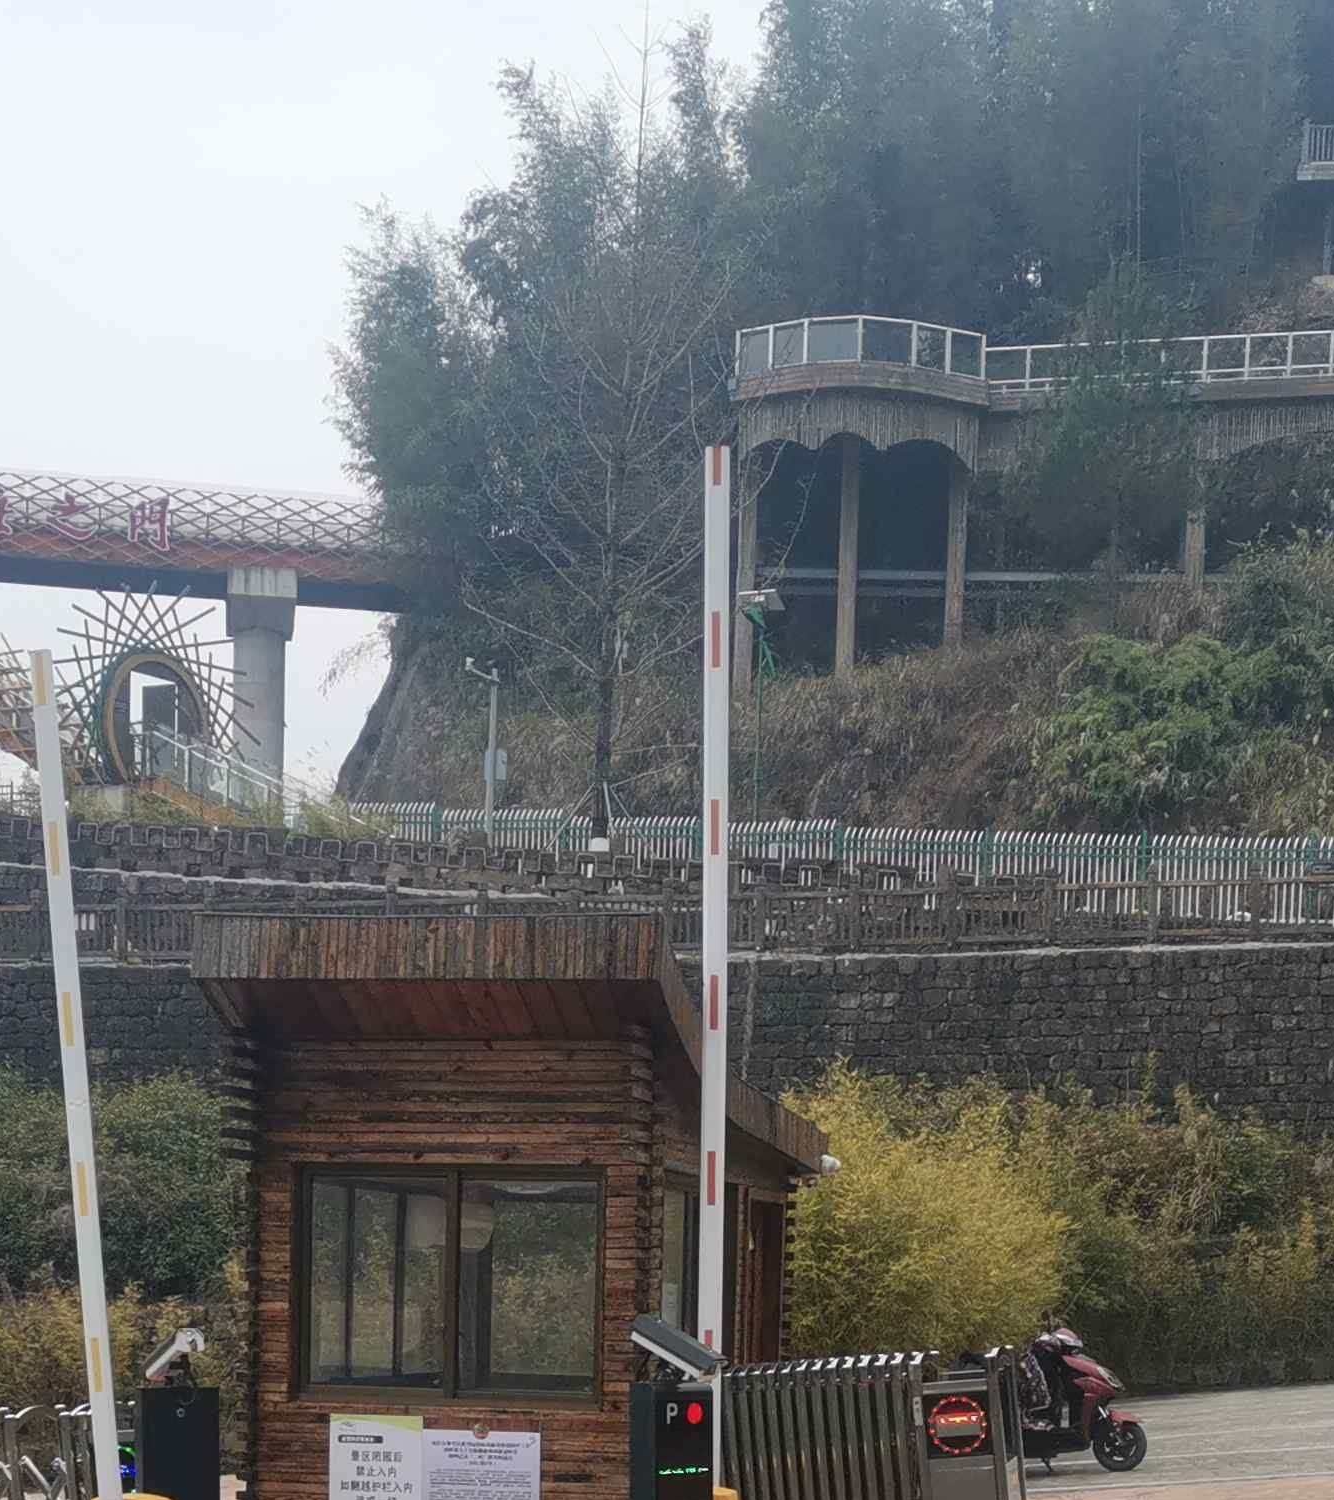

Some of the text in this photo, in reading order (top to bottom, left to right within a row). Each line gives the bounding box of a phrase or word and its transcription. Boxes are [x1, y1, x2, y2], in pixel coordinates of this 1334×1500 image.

[666, 1402, 678, 1424] P
[356, 1465, 397, 1478] 禁止入内
